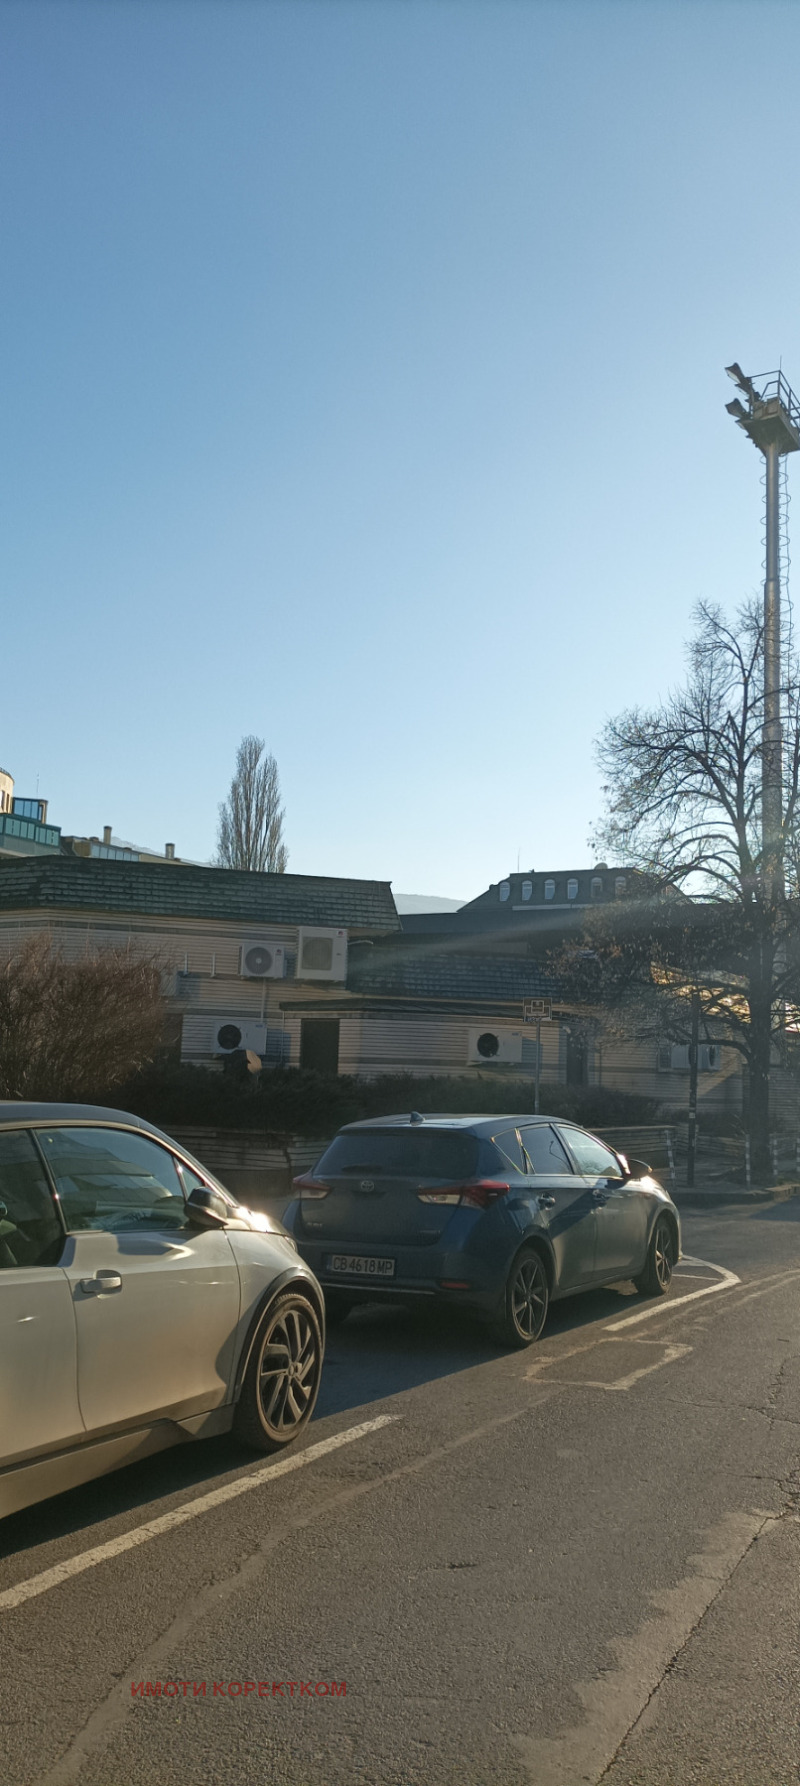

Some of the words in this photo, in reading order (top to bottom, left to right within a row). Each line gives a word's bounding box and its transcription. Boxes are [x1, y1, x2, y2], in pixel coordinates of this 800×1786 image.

[333, 1257, 347, 1270] CB
[349, 1258, 376, 1273] 4618
[377, 1260, 392, 1274] MP
